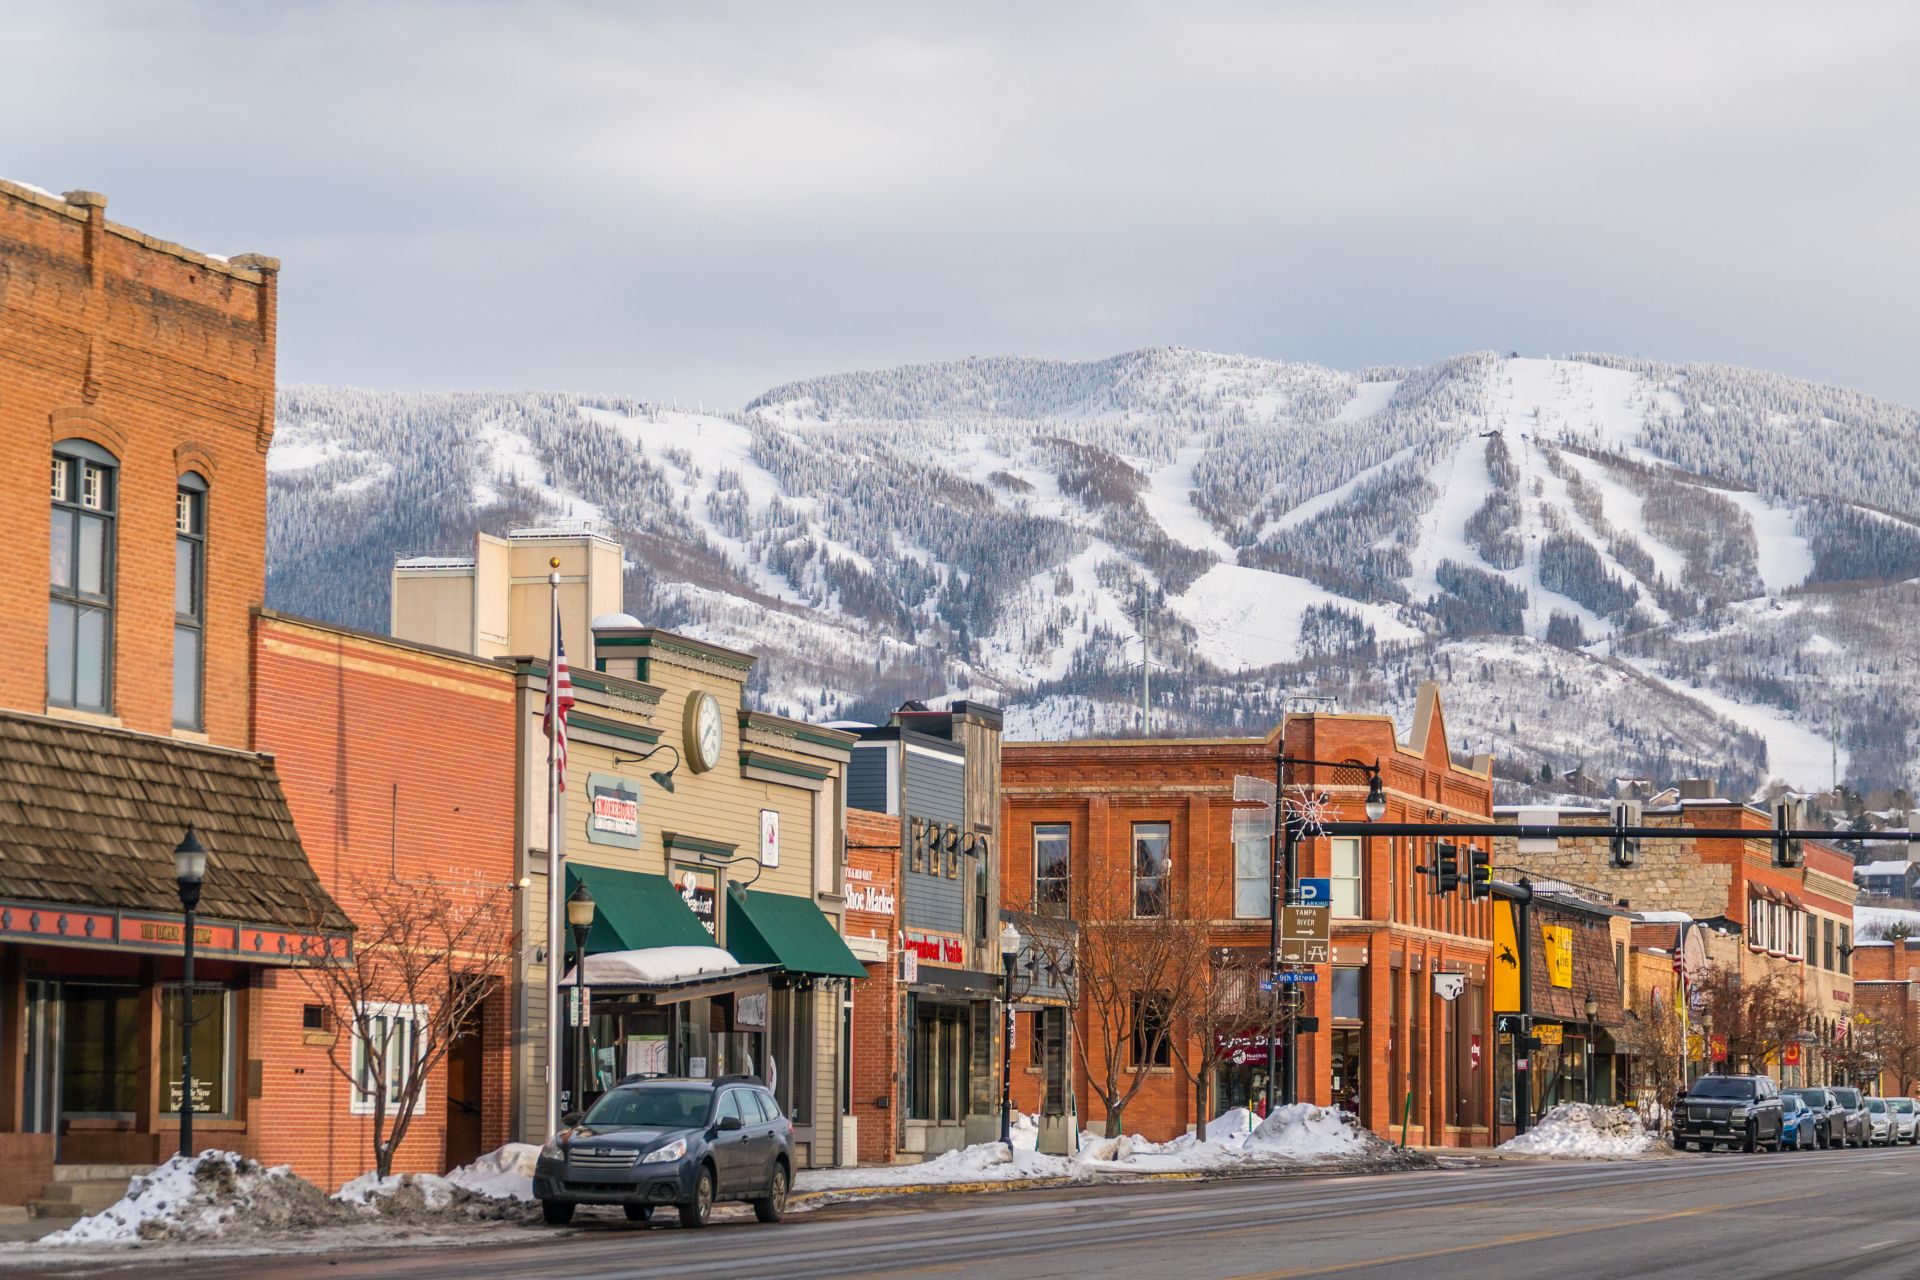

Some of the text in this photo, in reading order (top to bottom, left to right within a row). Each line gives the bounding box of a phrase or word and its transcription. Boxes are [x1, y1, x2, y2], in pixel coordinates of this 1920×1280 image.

[595, 797, 637, 822] SMOKEHOUSE
[845, 883, 895, 915] Shoe Market
[1295, 908, 1317, 916] YAMPA
[1296, 918, 1315, 926] RIVER
[943, 937, 963, 964] Nails
[1279, 974, 1316, 983] 9th Street
